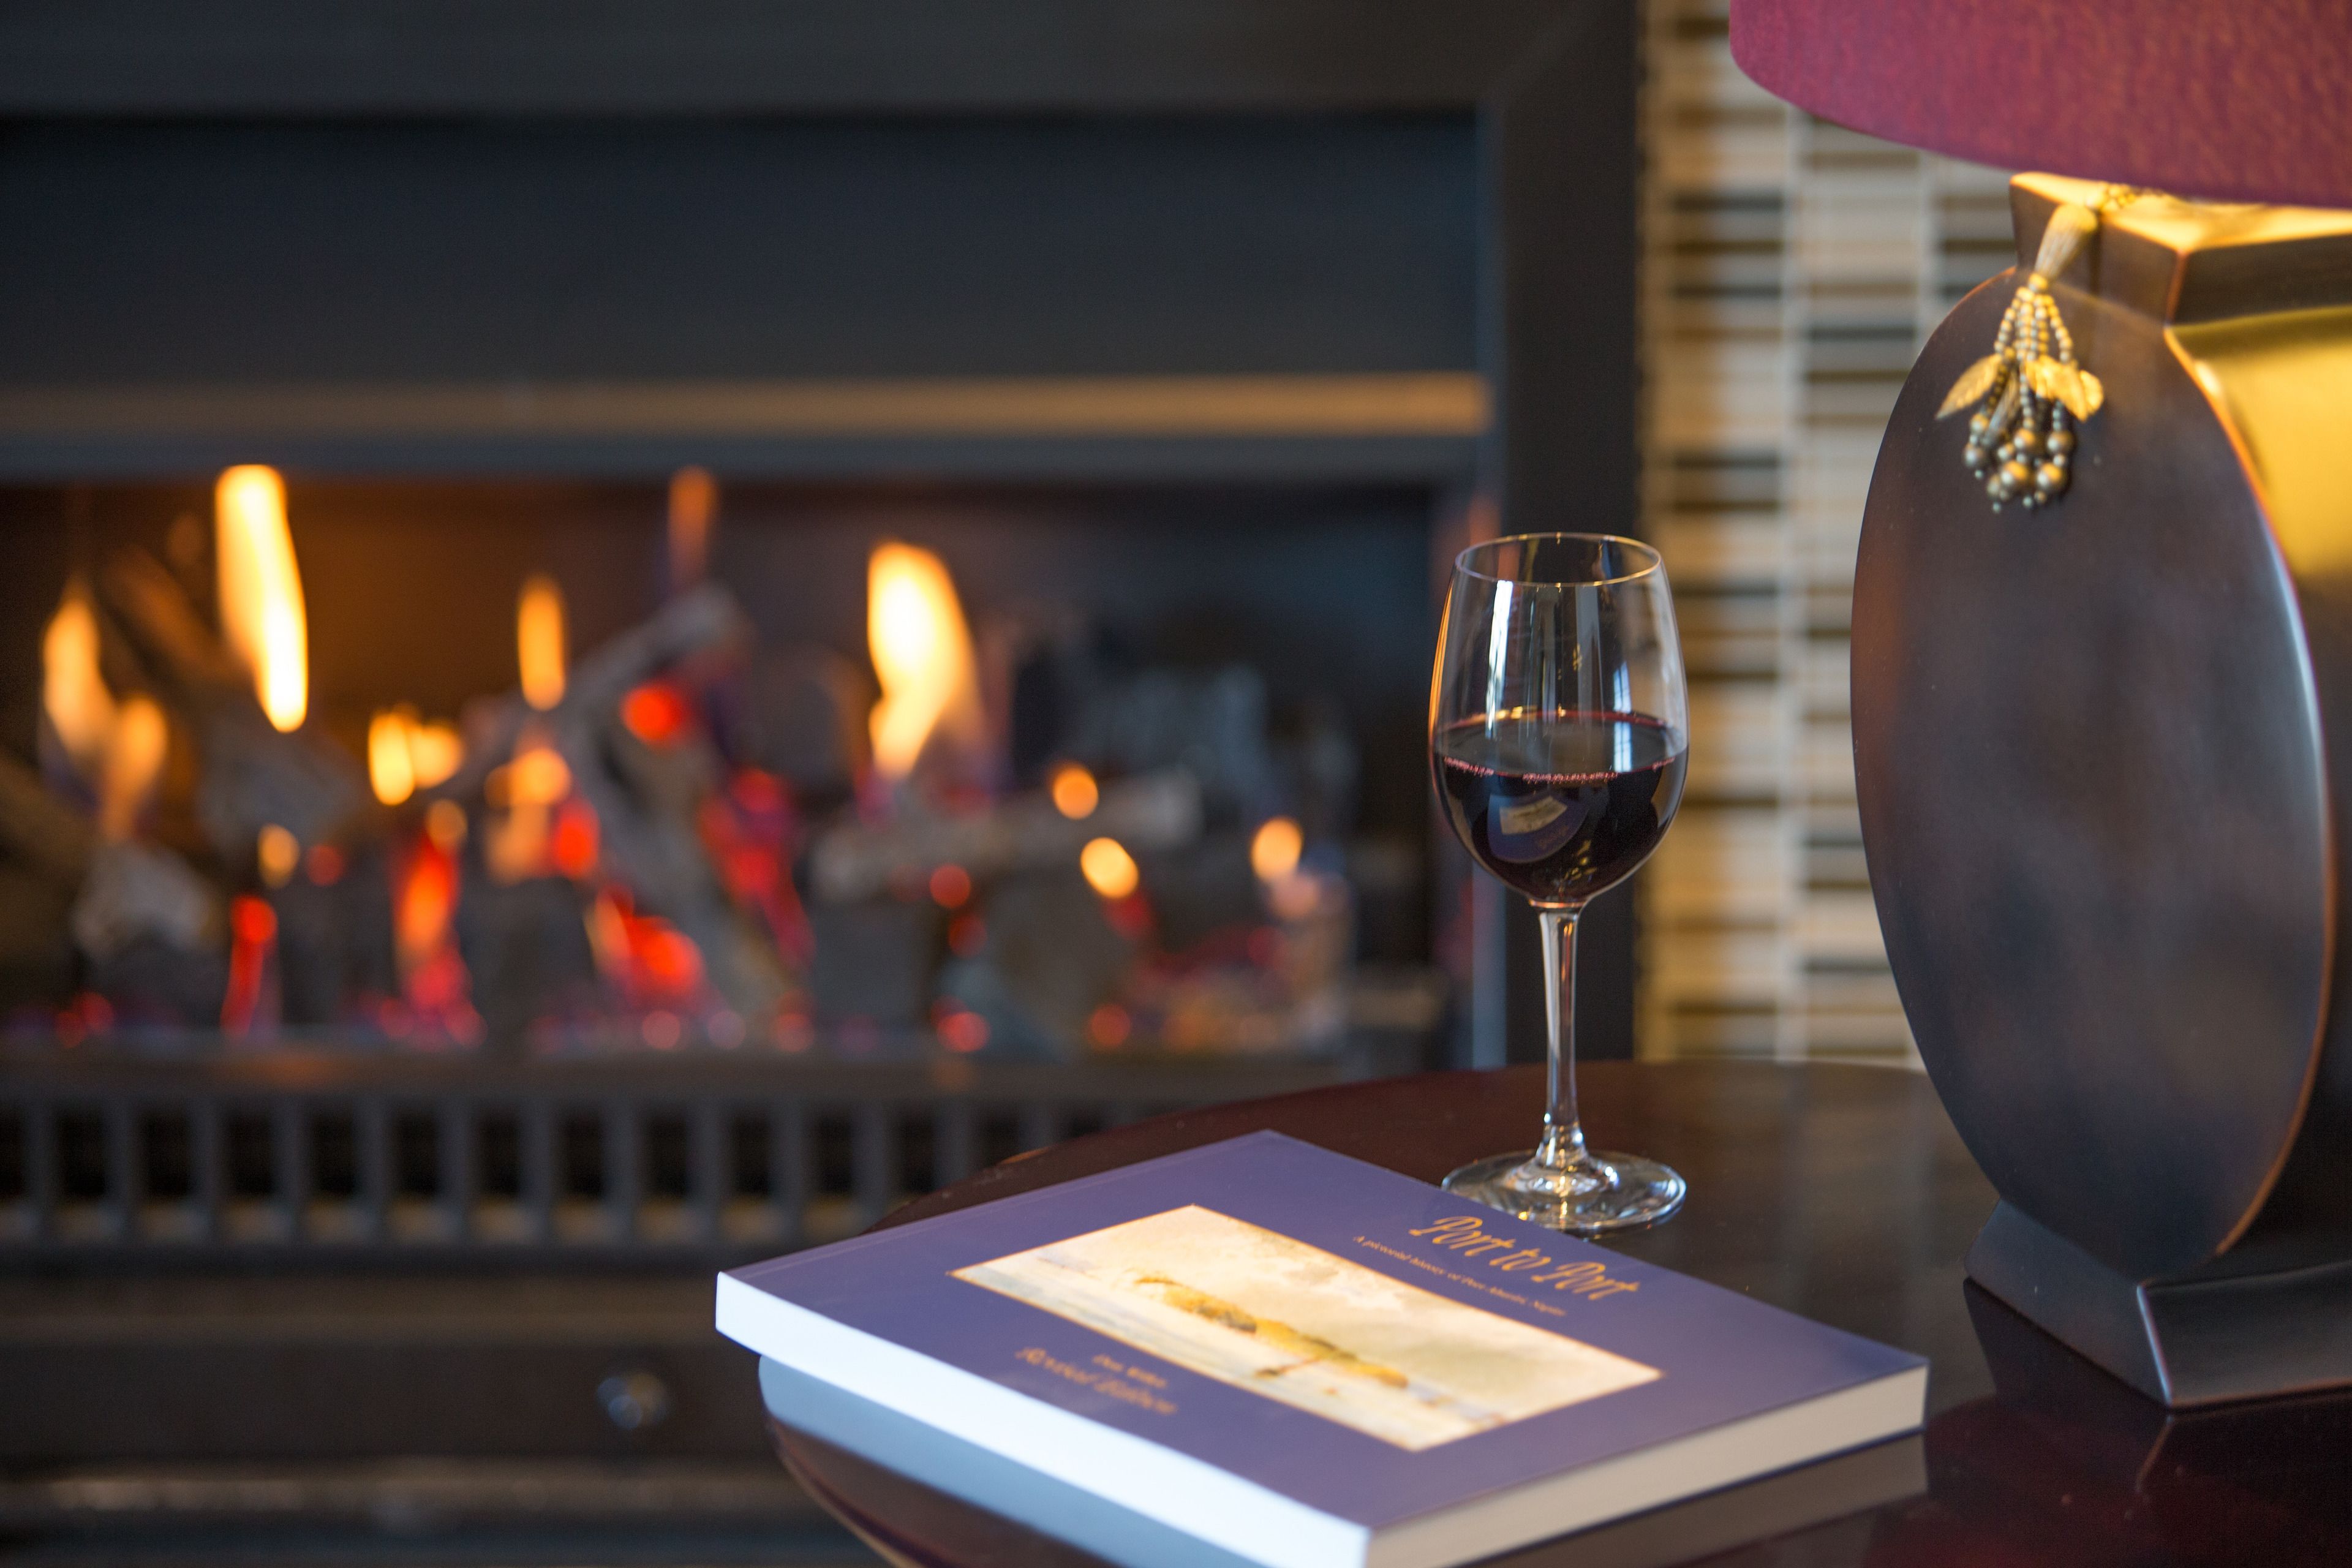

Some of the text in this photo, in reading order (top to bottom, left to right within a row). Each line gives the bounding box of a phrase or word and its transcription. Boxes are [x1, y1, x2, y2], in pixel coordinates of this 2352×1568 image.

[1409, 1216, 1640, 1301] Port to Port
